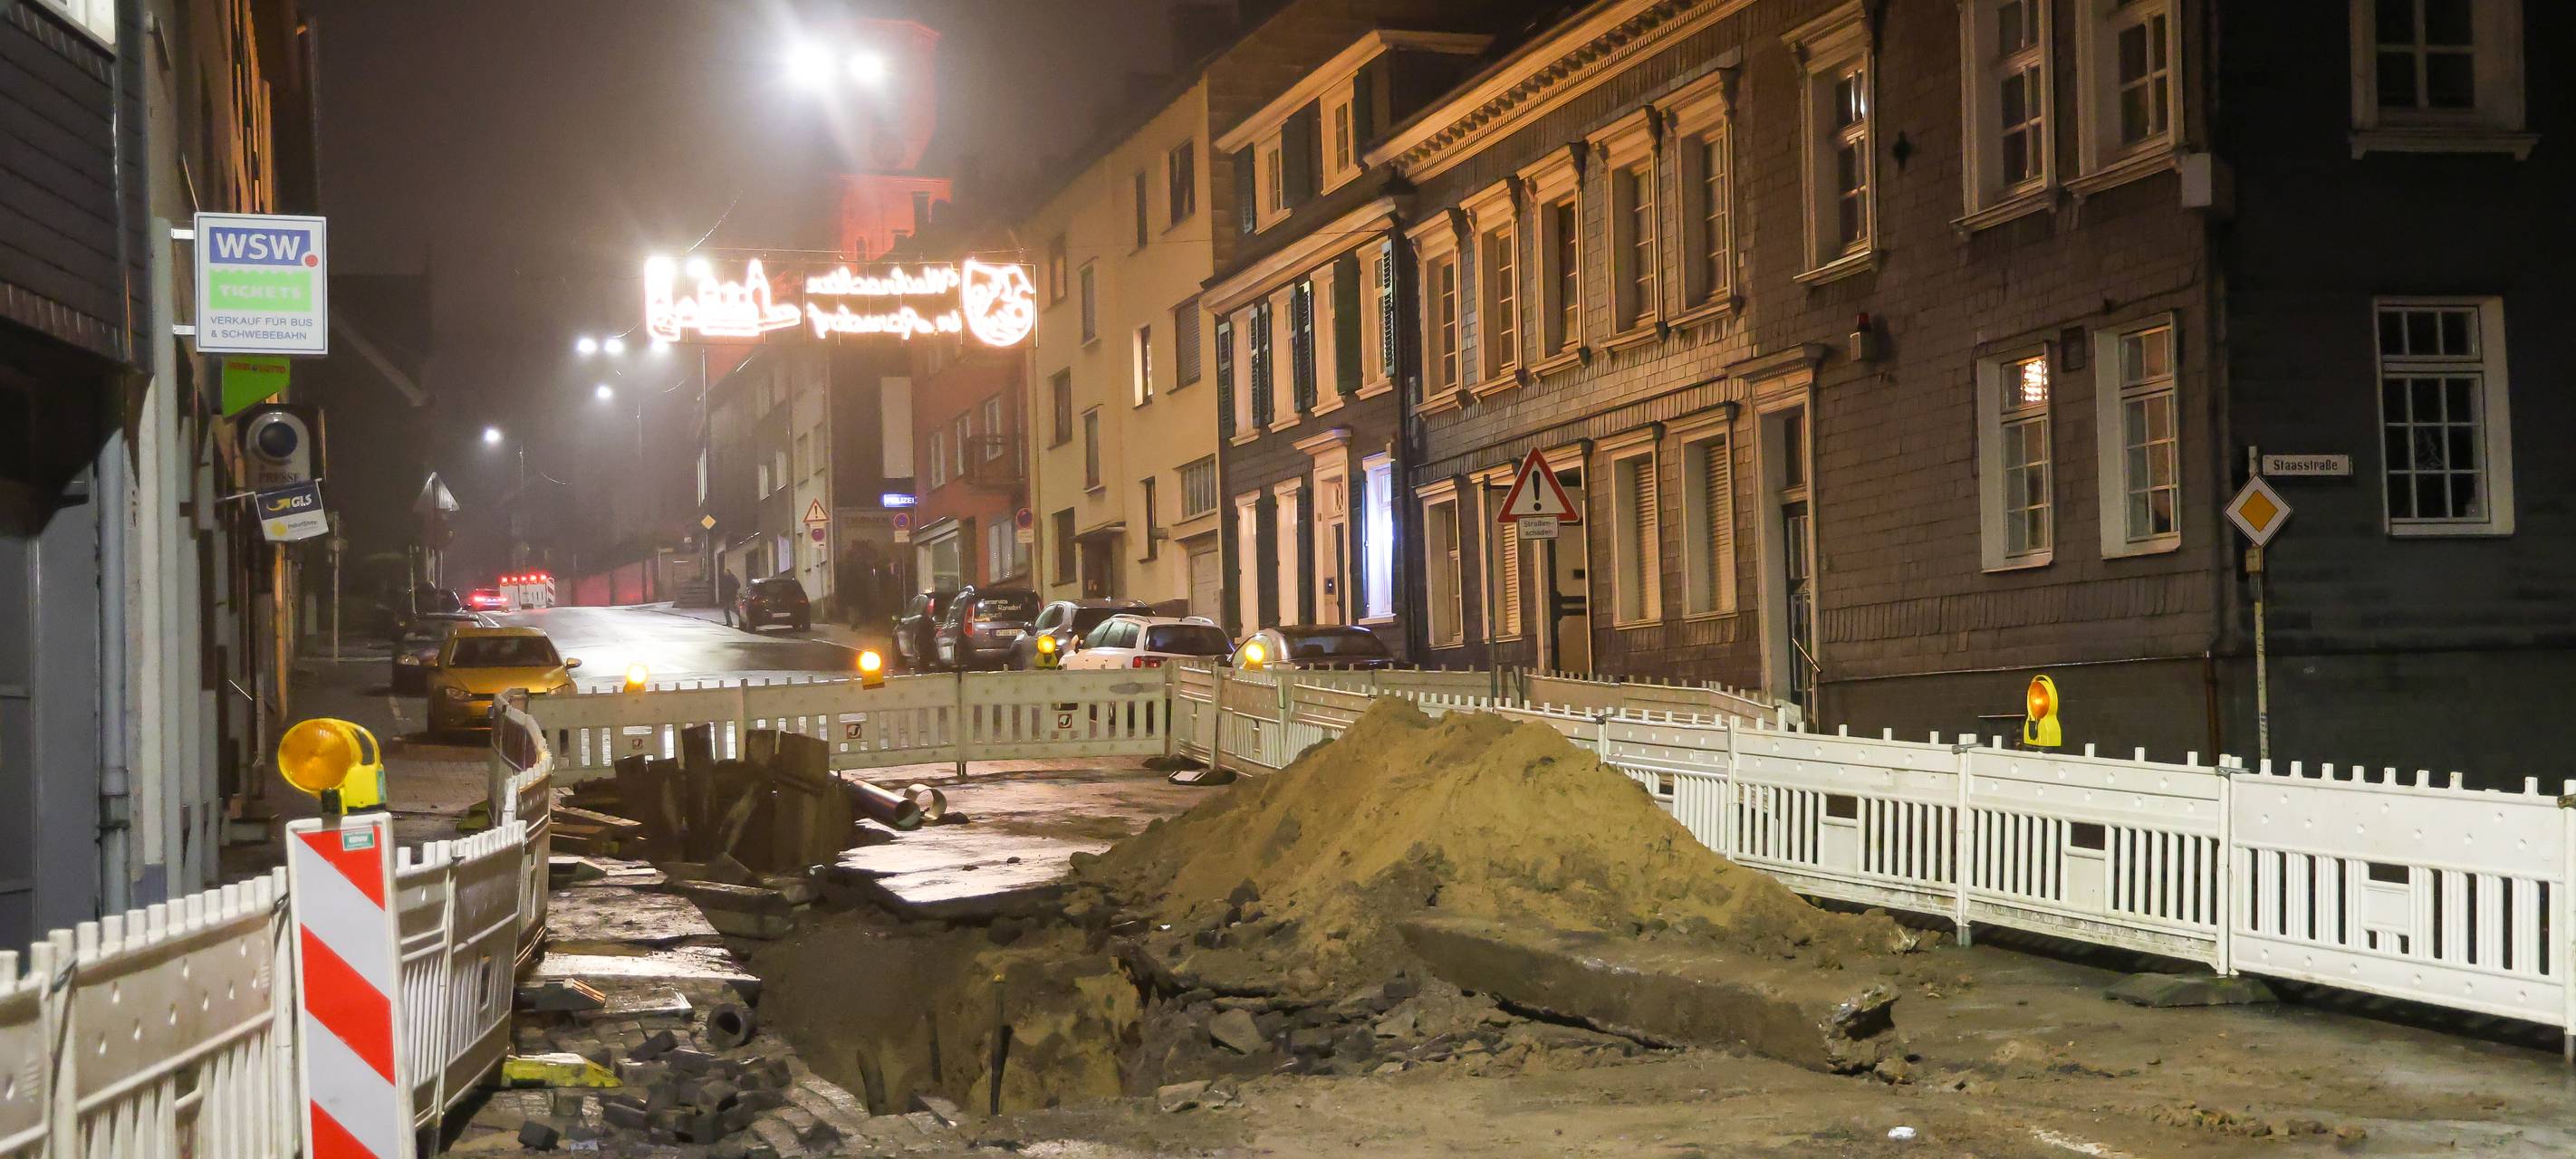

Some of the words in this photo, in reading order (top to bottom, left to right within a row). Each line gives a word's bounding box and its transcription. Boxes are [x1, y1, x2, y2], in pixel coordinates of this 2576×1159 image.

[216, 233, 301, 260] WSW
[219, 284, 302, 299] TICKETS
[210, 316, 262, 326] VERKAUF
[265, 316, 287, 327] FÜR
[291, 318, 313, 327] BUS
[211, 330, 217, 338] &
[221, 330, 307, 340] SCHWEBEBAHN
[2273, 459, 2339, 472] Staasstraße
[291, 493, 312, 508] GLS
[886, 496, 915, 504] LIZEI
